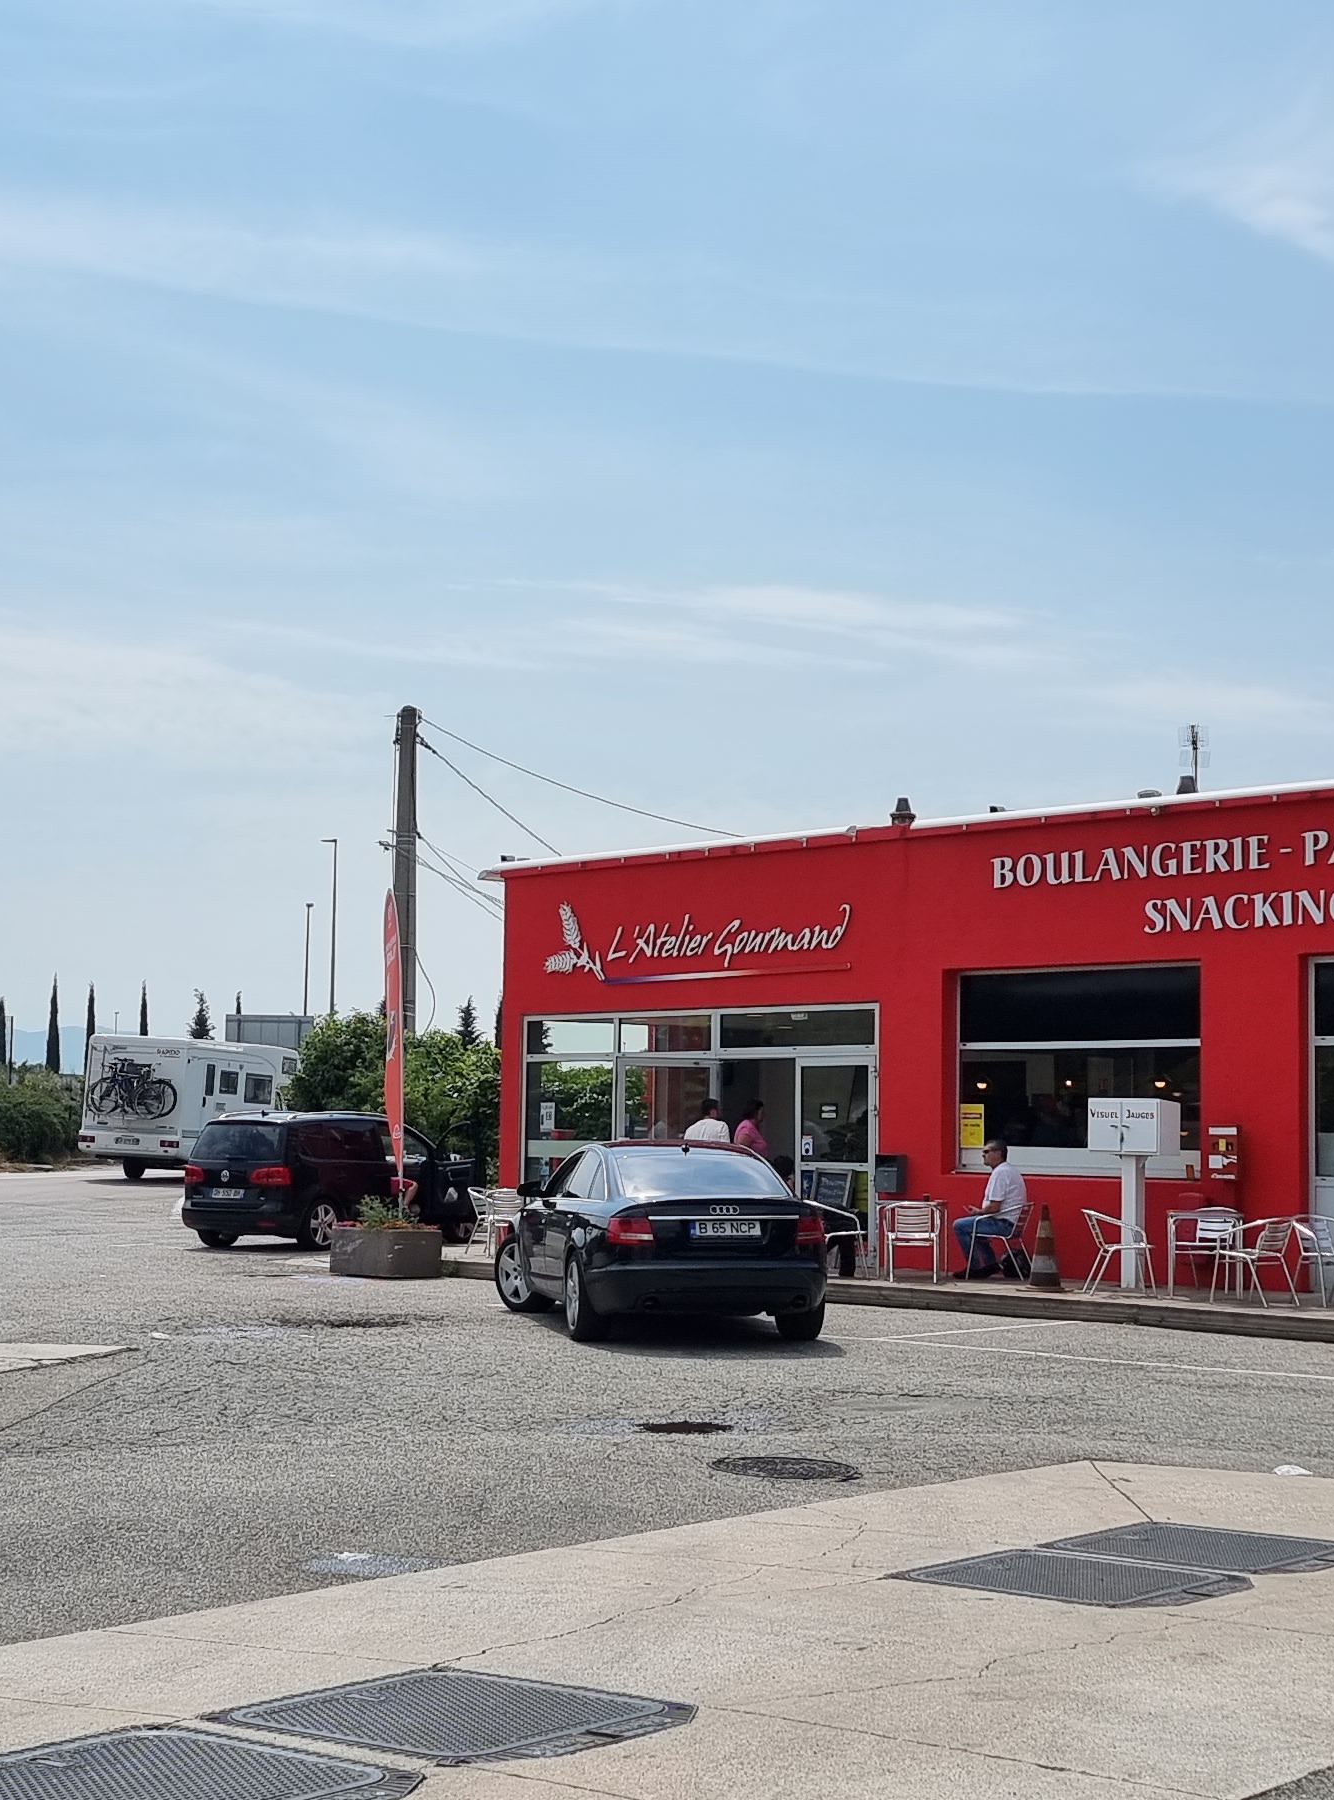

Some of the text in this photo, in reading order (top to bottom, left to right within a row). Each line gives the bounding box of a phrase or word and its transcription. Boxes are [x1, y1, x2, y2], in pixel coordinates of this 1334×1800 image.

[990, 834, 1270, 889] BOULANGERIE
[607, 904, 851, 967] L'Atelier Gourmand
[699, 1222, 756, 1234] B 65 NCP
